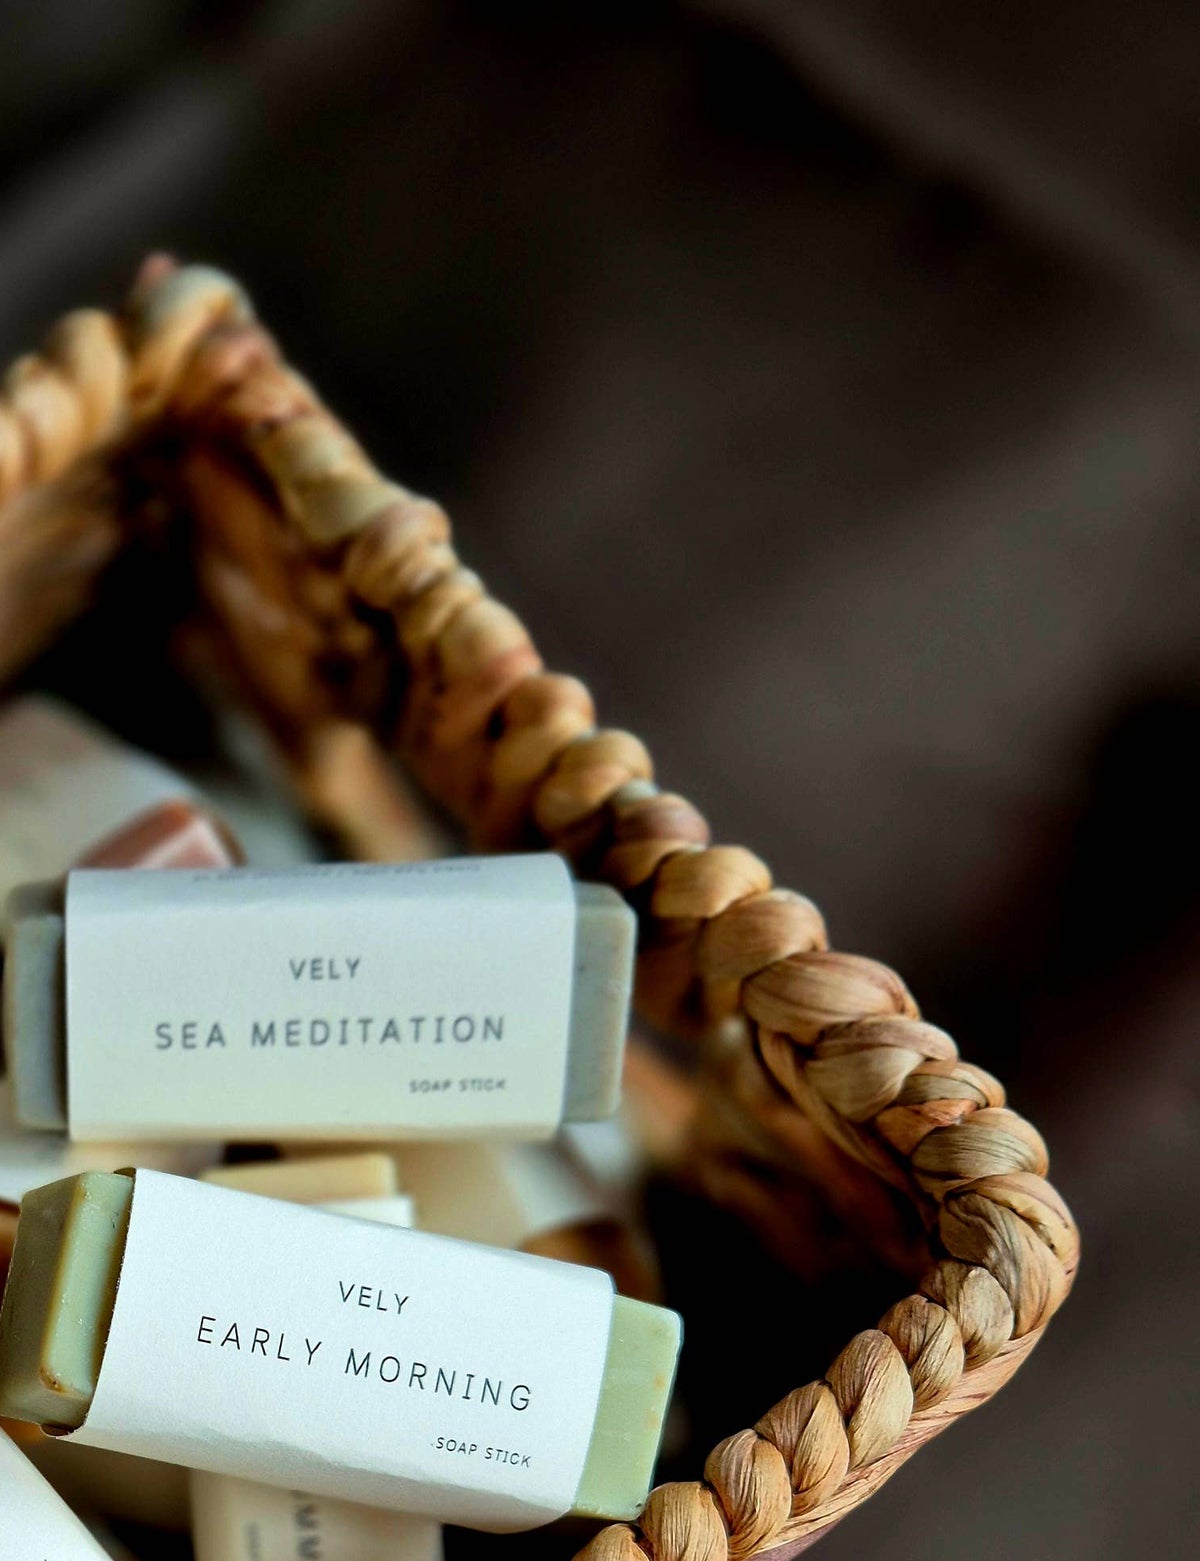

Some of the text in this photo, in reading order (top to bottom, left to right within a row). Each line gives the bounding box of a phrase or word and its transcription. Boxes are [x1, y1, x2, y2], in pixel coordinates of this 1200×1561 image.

[289, 957, 361, 981] VELY
[155, 1014, 504, 1051] SEA MEDITATION
[458, 1078, 506, 1092] STICK
[339, 1281, 409, 1314] VELY
[197, 1316, 531, 1411] EARLY MORNING
[436, 1437, 531, 1468] SOAP STICK
